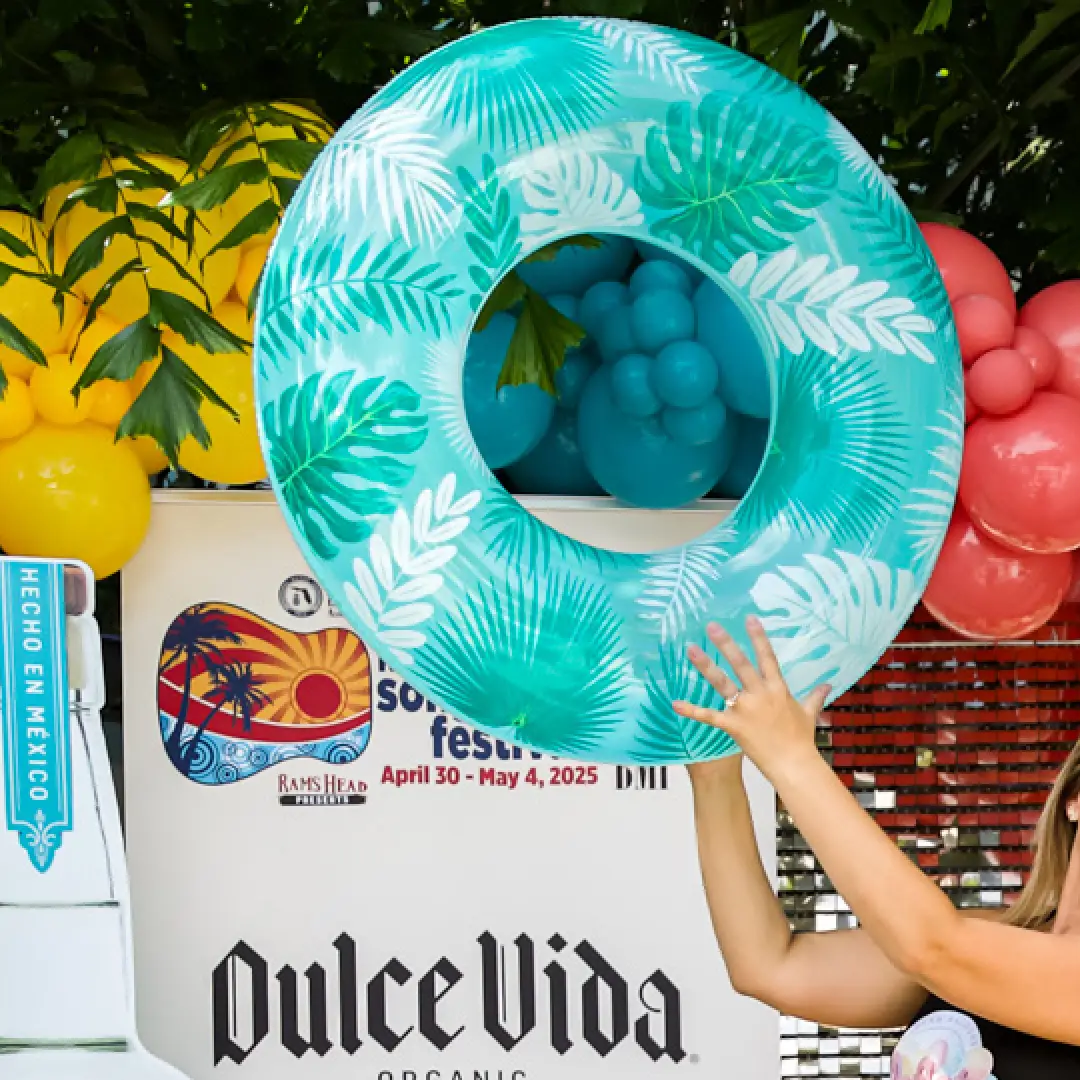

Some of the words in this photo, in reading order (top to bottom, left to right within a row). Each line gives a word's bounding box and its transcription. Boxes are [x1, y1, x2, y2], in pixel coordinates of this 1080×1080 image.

[20, 568, 42, 652] HECHO
[24, 664, 43, 694] EN
[26, 707, 50, 801] MÉXICO
[381, 765, 430, 789] April
[435, 766, 460, 785] 30
[479, 767, 519, 789] May
[525, 766, 545, 788] 4,
[550, 766, 598, 785] 2025
[212, 931, 466, 1067] Dulce
[476, 929, 687, 1065] Vida
